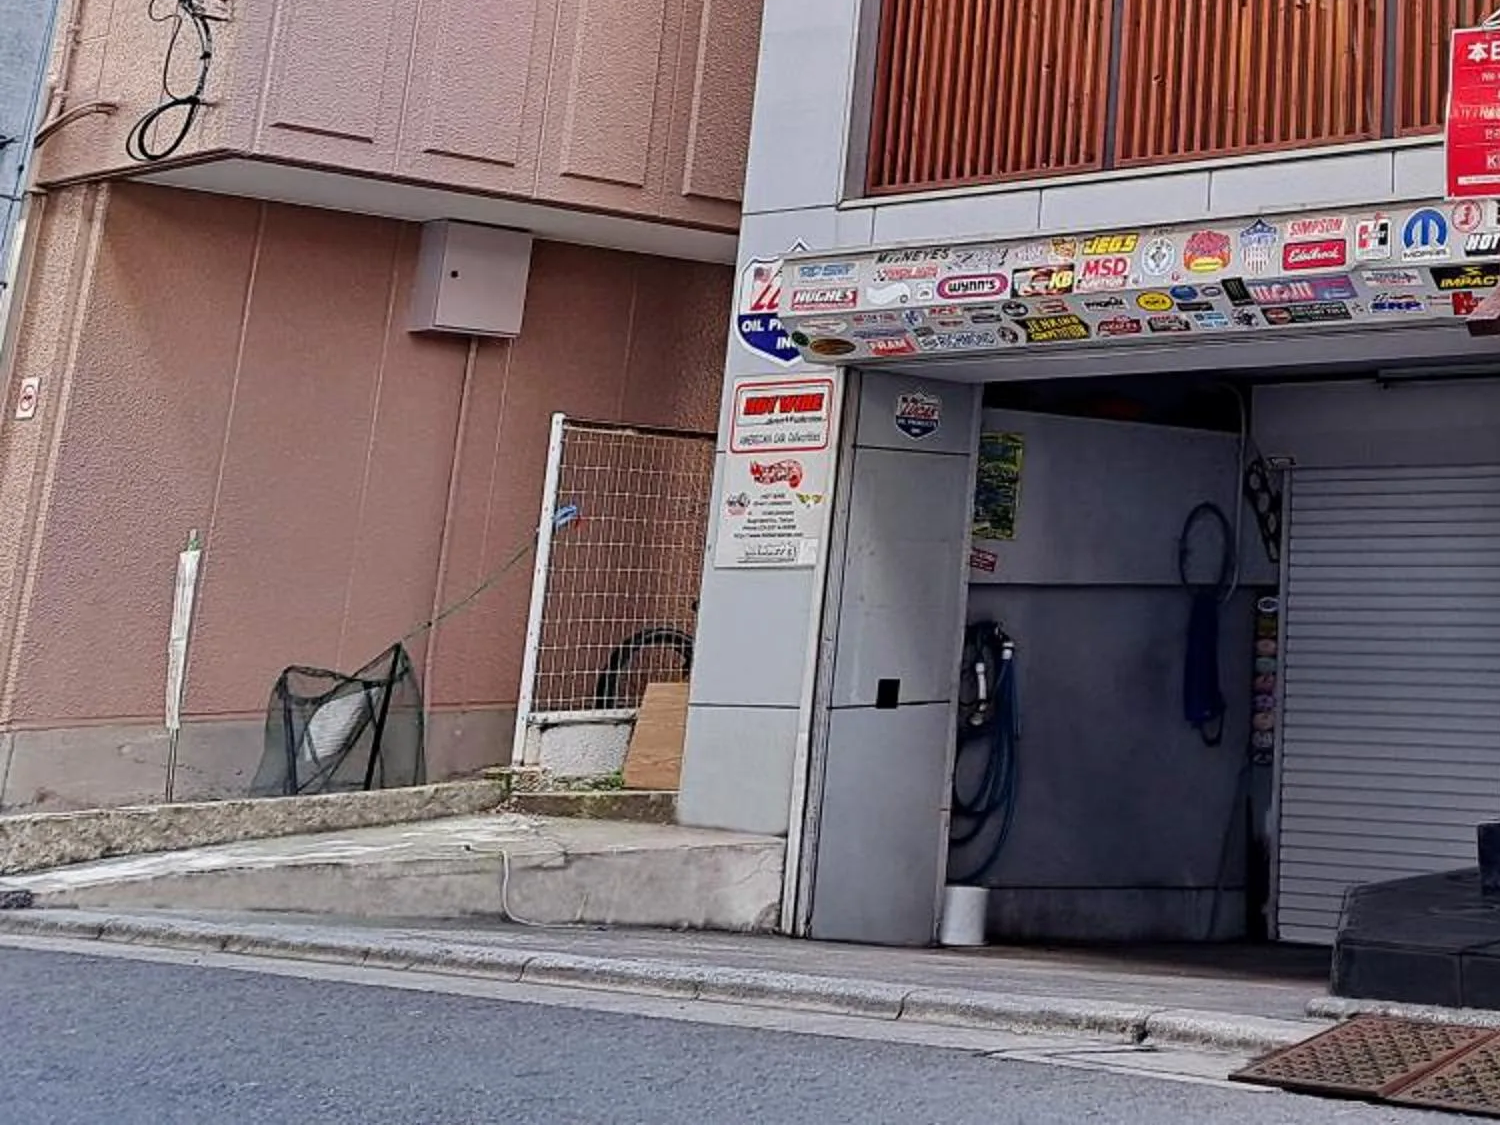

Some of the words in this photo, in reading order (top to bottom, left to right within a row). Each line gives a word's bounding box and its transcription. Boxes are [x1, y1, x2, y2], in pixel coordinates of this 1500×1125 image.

[1289, 218, 1344, 236] SIMPSON
[1083, 258, 1128, 276] MSD
[794, 289, 855, 304] HUGHES
[741, 320, 765, 333] OIL
